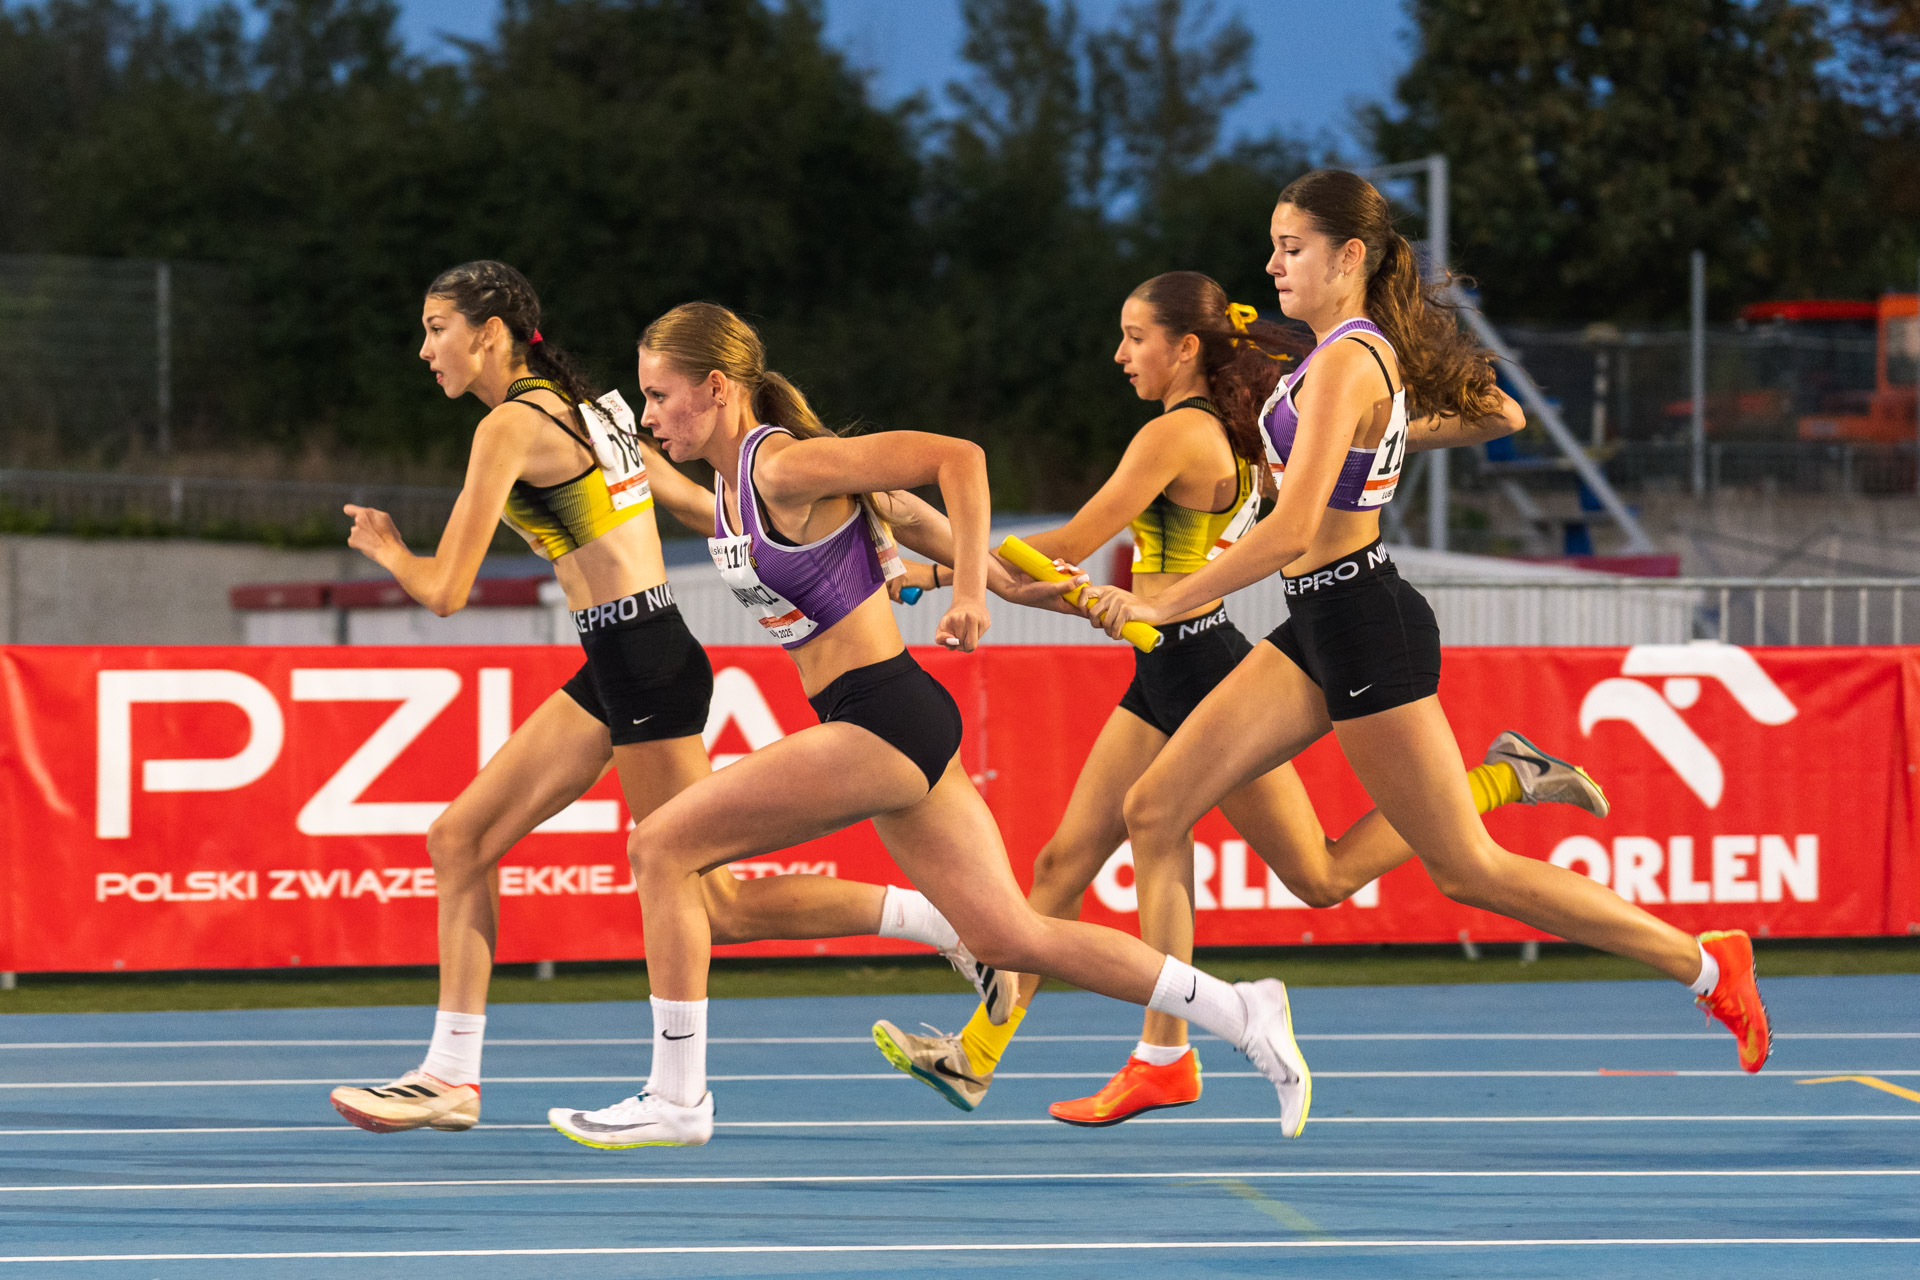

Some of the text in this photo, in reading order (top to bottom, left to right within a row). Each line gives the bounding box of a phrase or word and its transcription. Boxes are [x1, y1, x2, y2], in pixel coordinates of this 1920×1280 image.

[1178, 607, 1227, 641] NIKE
[95, 870, 258, 902] POLSKI
[267, 867, 438, 904] ZWIĄZE
[499, 864, 638, 897] EKKIEJ
[1548, 834, 1819, 904] ORLEN
